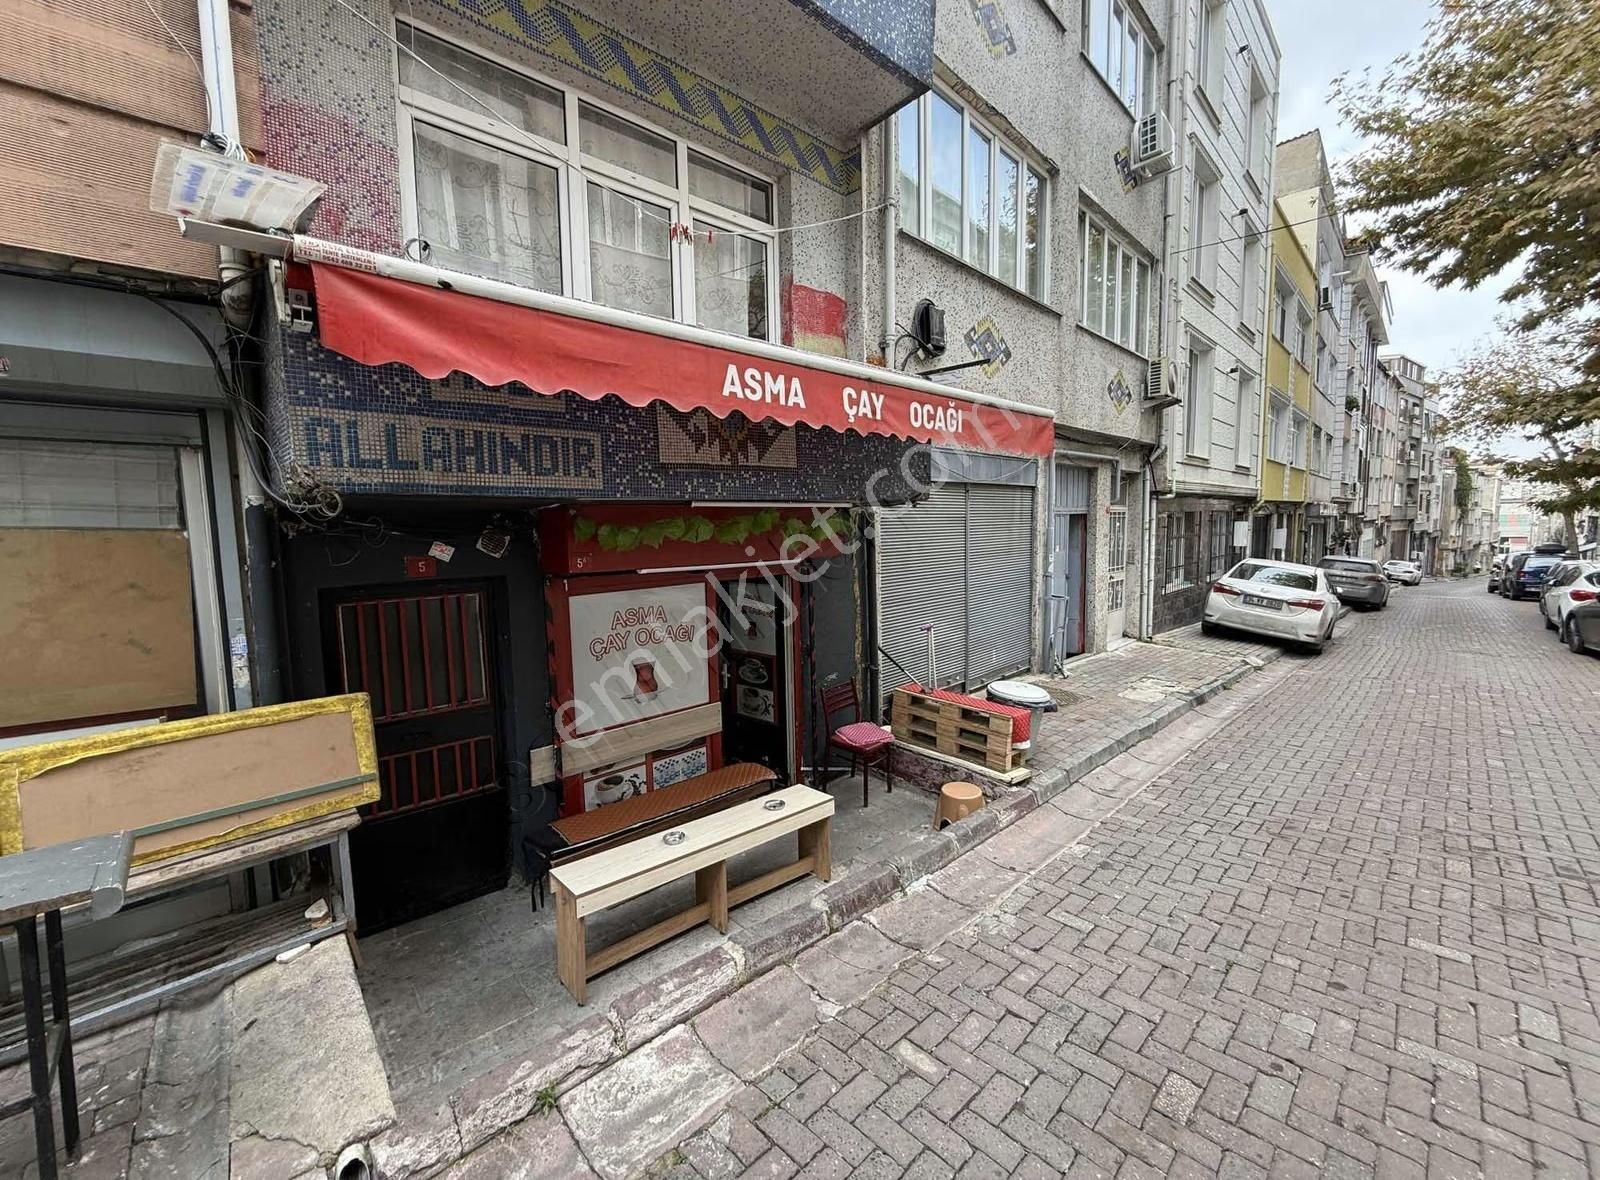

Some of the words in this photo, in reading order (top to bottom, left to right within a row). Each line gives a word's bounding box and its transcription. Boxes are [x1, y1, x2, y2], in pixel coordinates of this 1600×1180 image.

[722, 364, 806, 409] ASMA
[842, 386, 885, 423] ÇAY
[909, 401, 963, 434] OCAĞI
[418, 561, 426, 573] 5
[611, 605, 667, 630] ASMA
[590, 630, 631, 661] ÇAY
